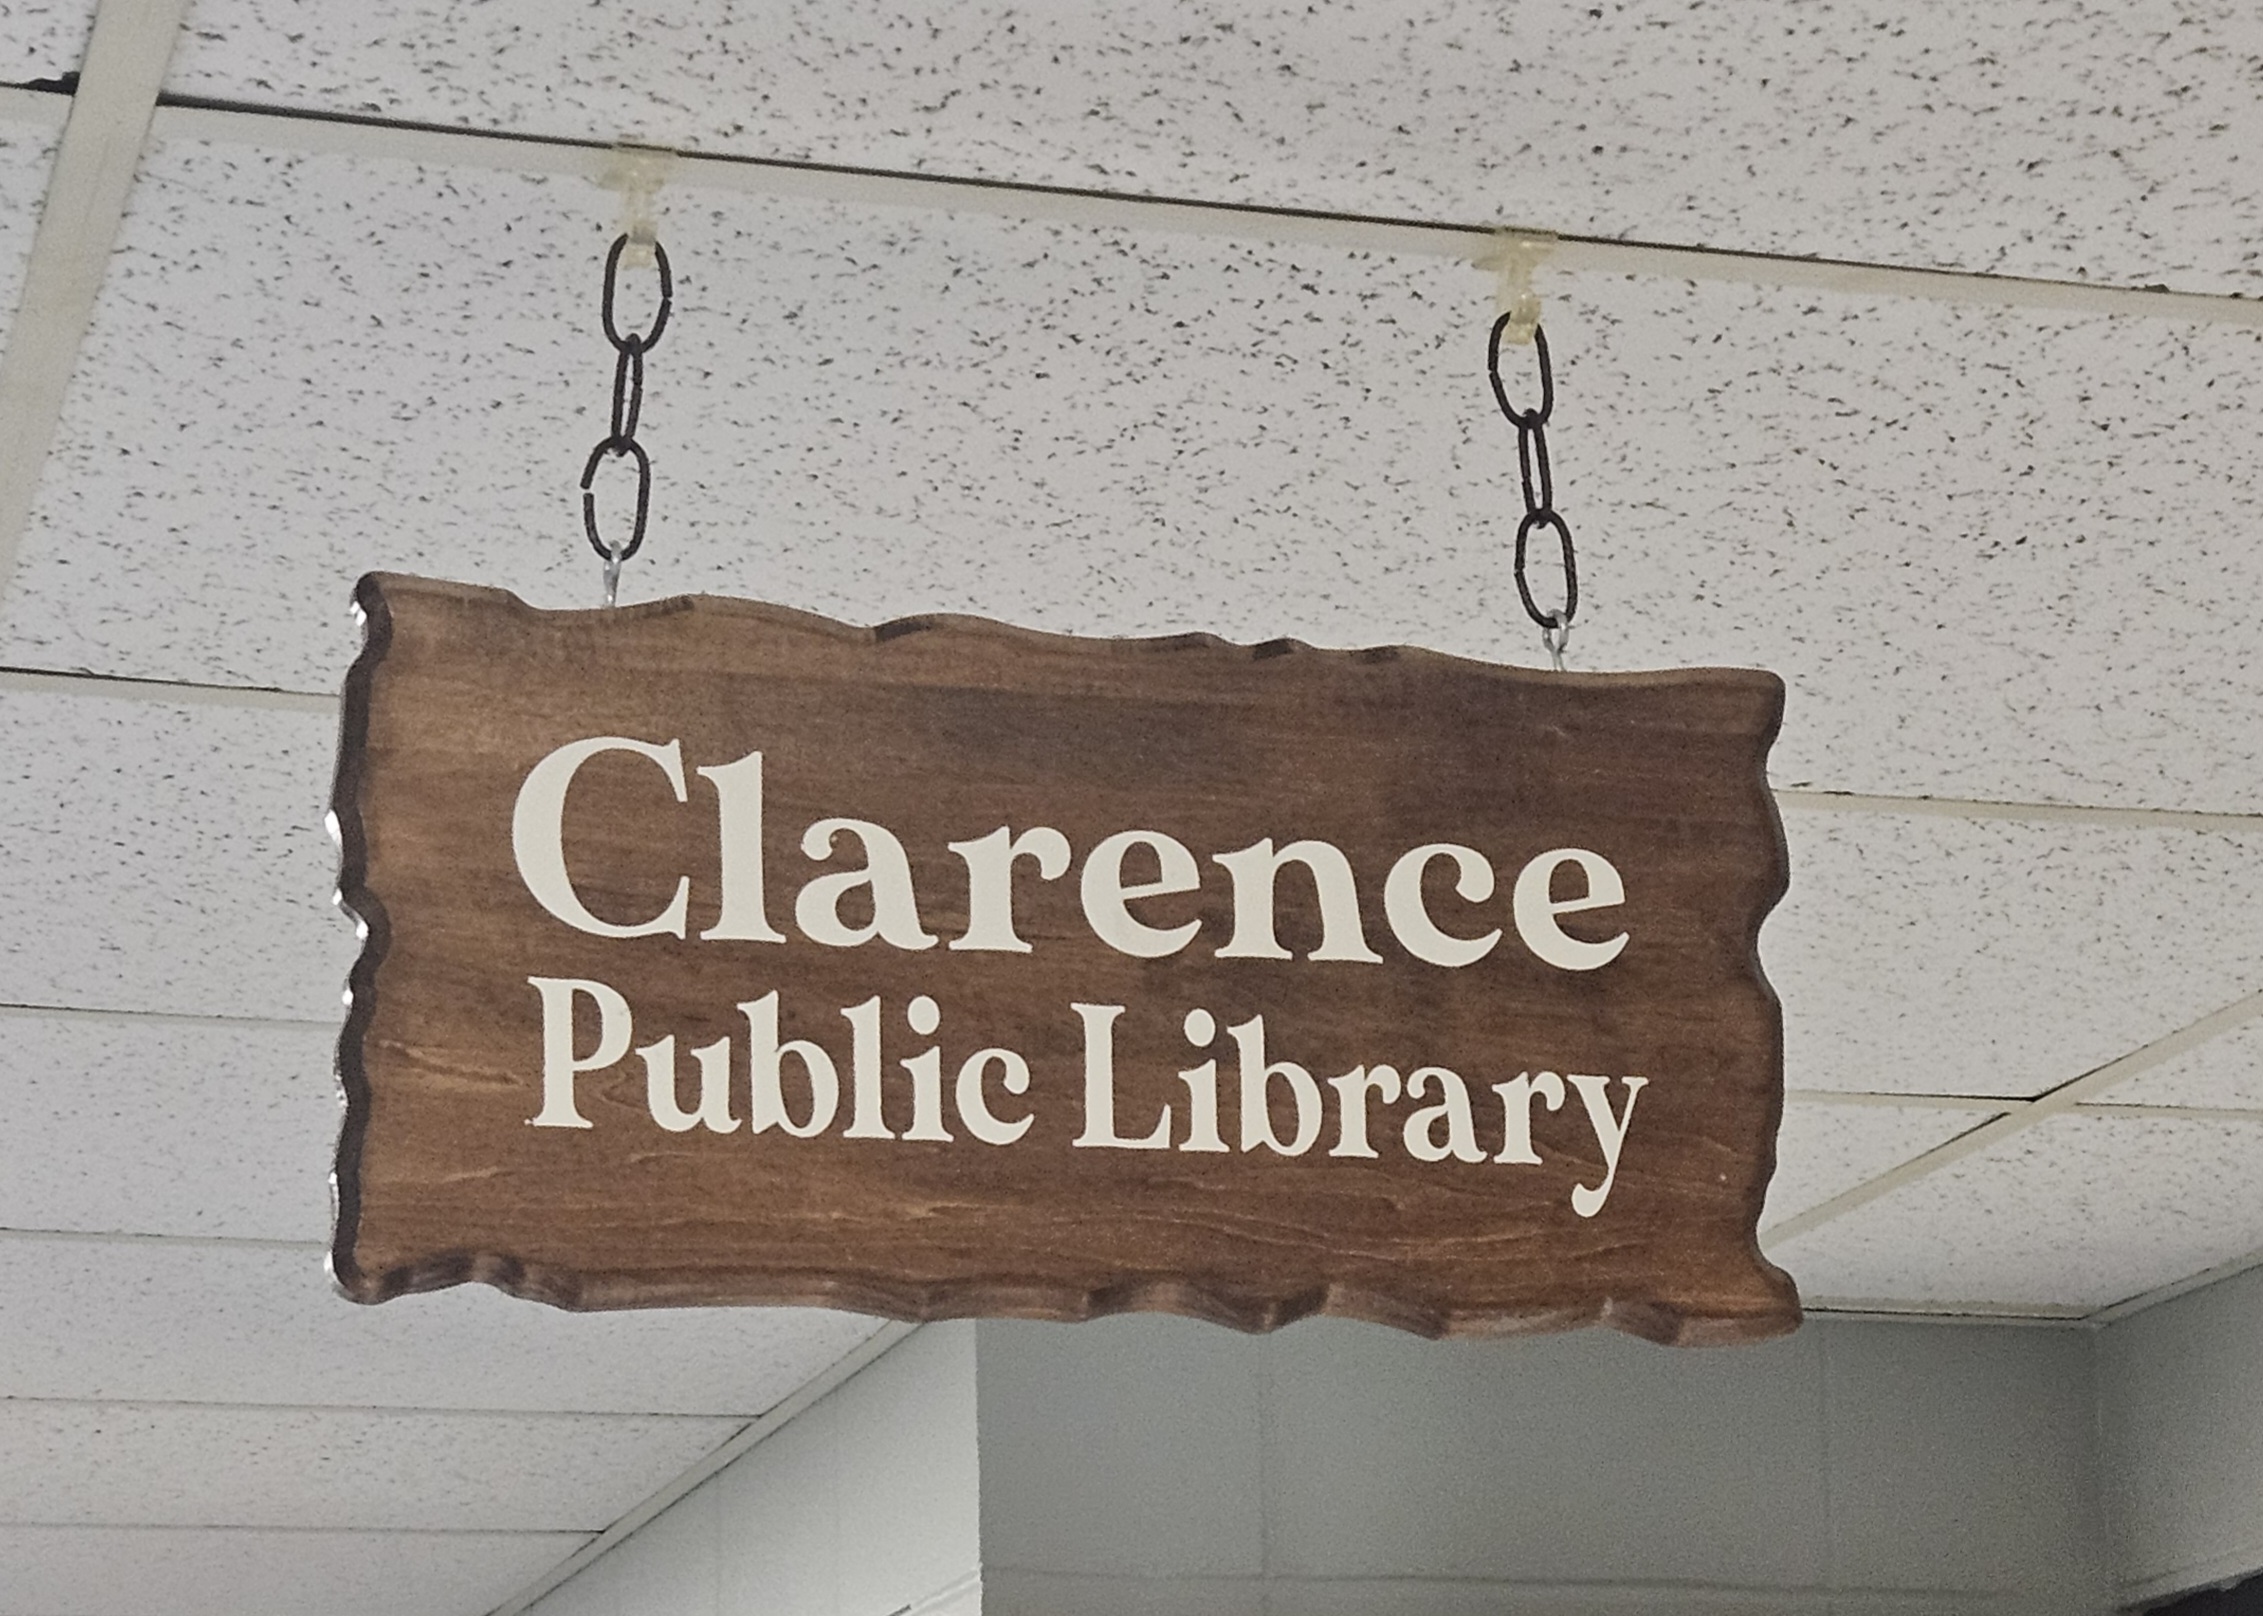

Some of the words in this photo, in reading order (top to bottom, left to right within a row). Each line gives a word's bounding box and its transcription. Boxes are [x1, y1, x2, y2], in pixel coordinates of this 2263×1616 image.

[511, 736, 1630, 971] Clarence
[526, 976, 1035, 1146] Public
[1071, 1002, 1649, 1218] Library
